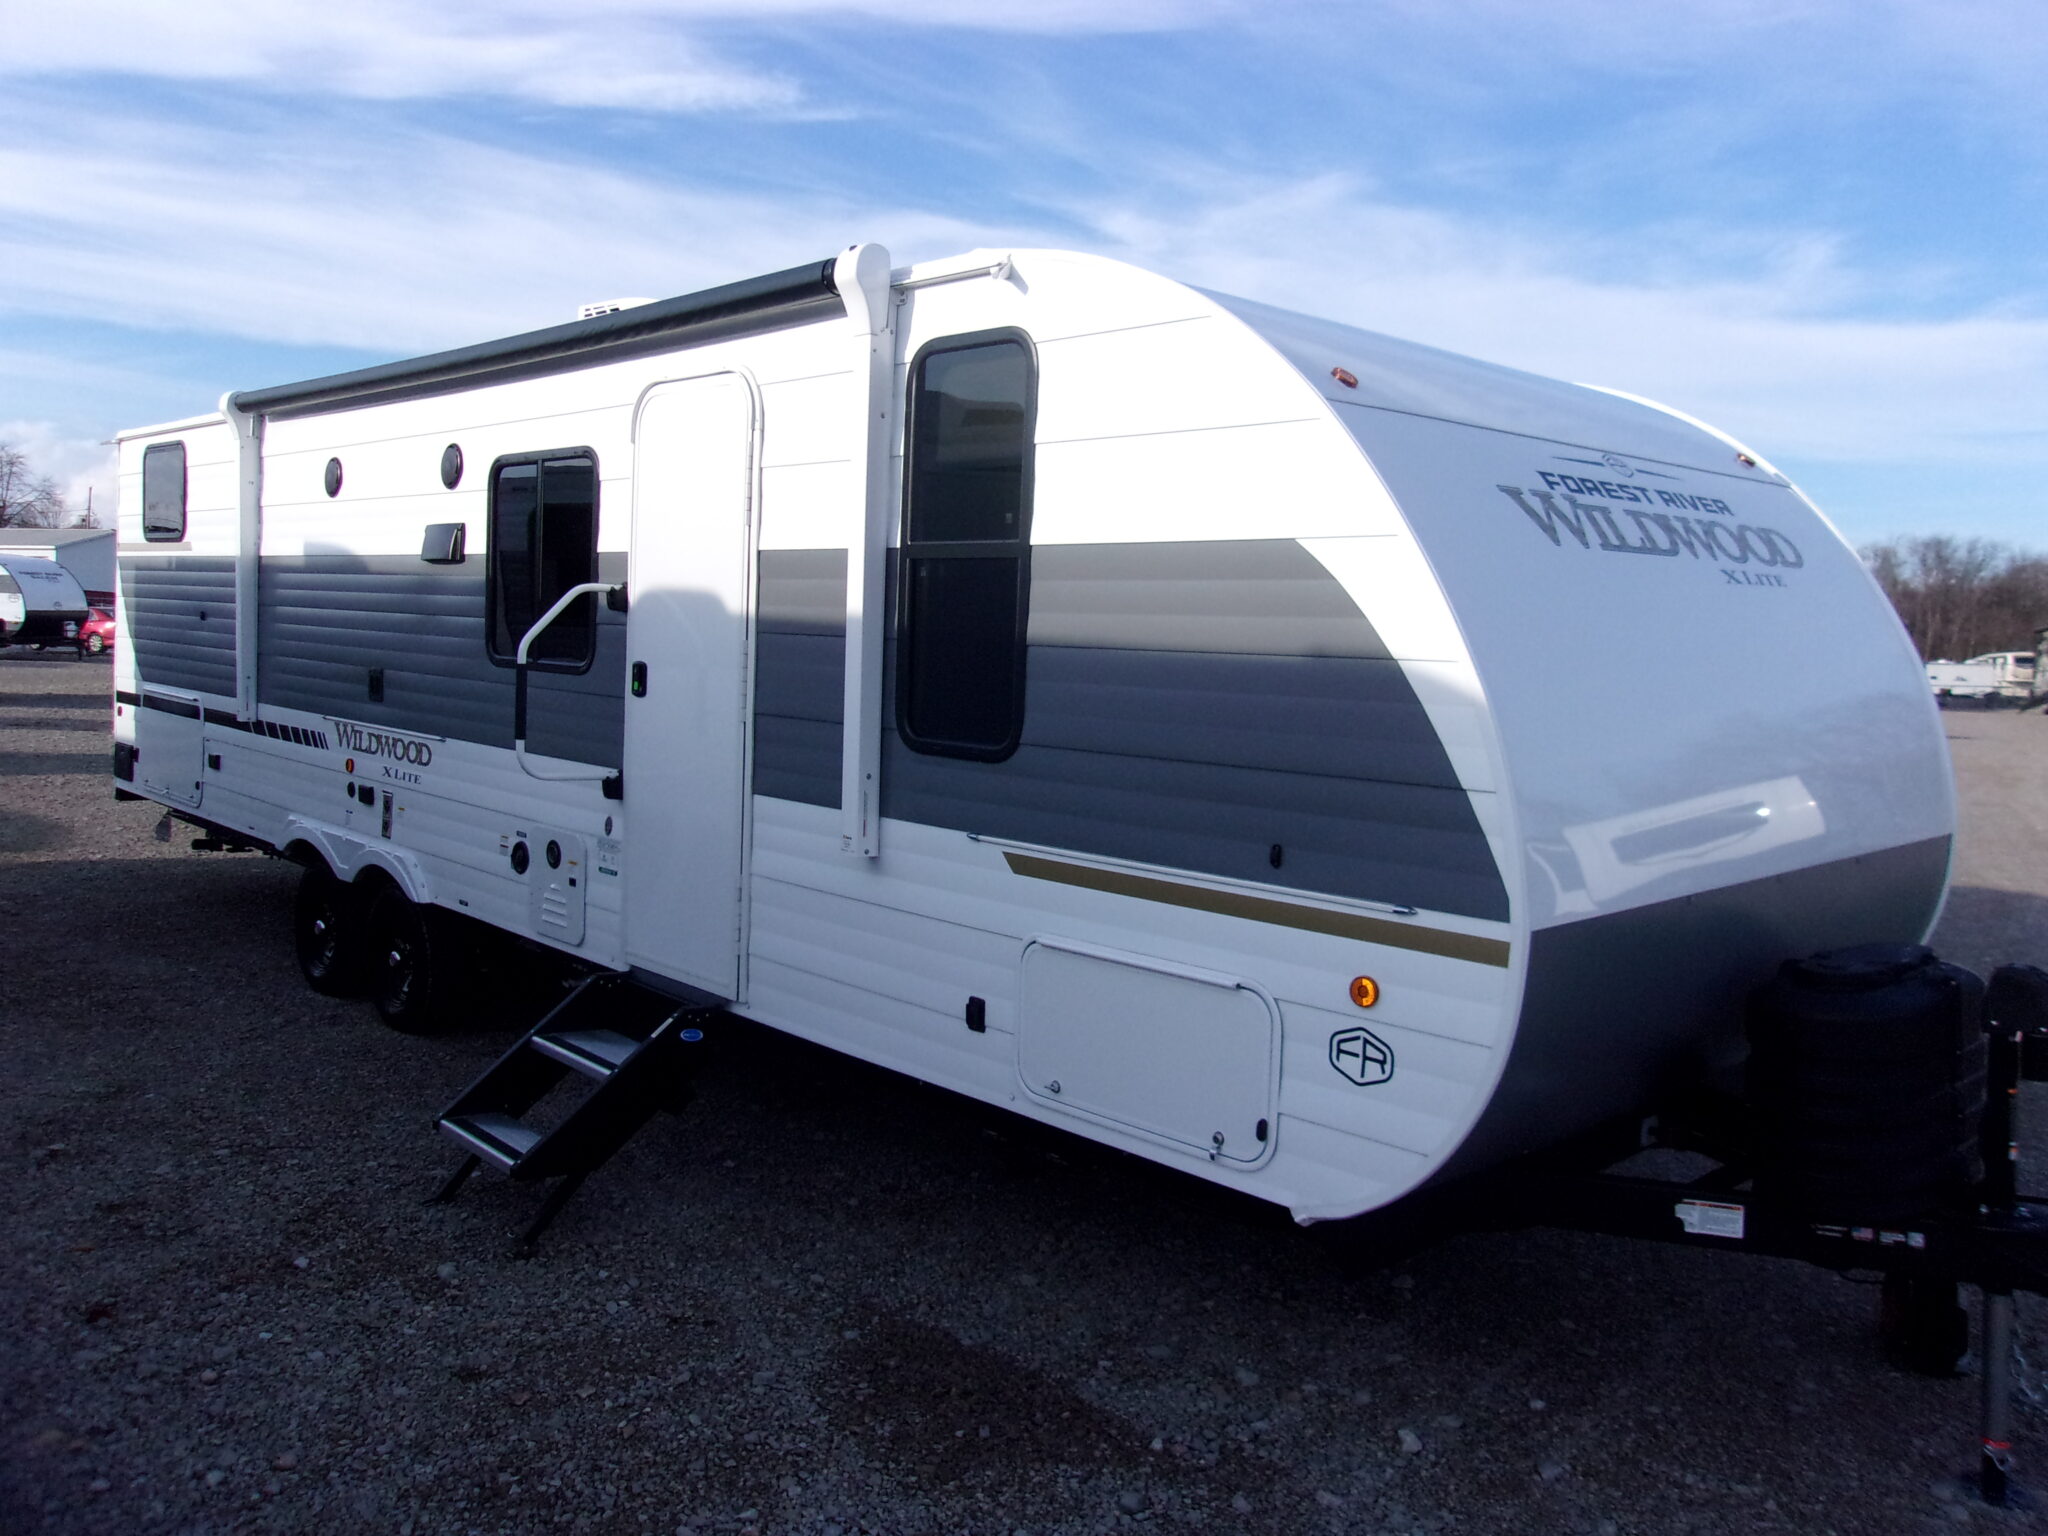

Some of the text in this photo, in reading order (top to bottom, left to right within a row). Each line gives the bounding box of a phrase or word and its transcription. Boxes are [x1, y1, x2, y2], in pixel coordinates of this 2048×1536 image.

[1536, 470, 1735, 517] FOREST RIVER
[1496, 484, 1804, 569] WILDWOOD
[334, 720, 432, 767] WILDWOOD
[1336, 1034, 1387, 1079] FR
